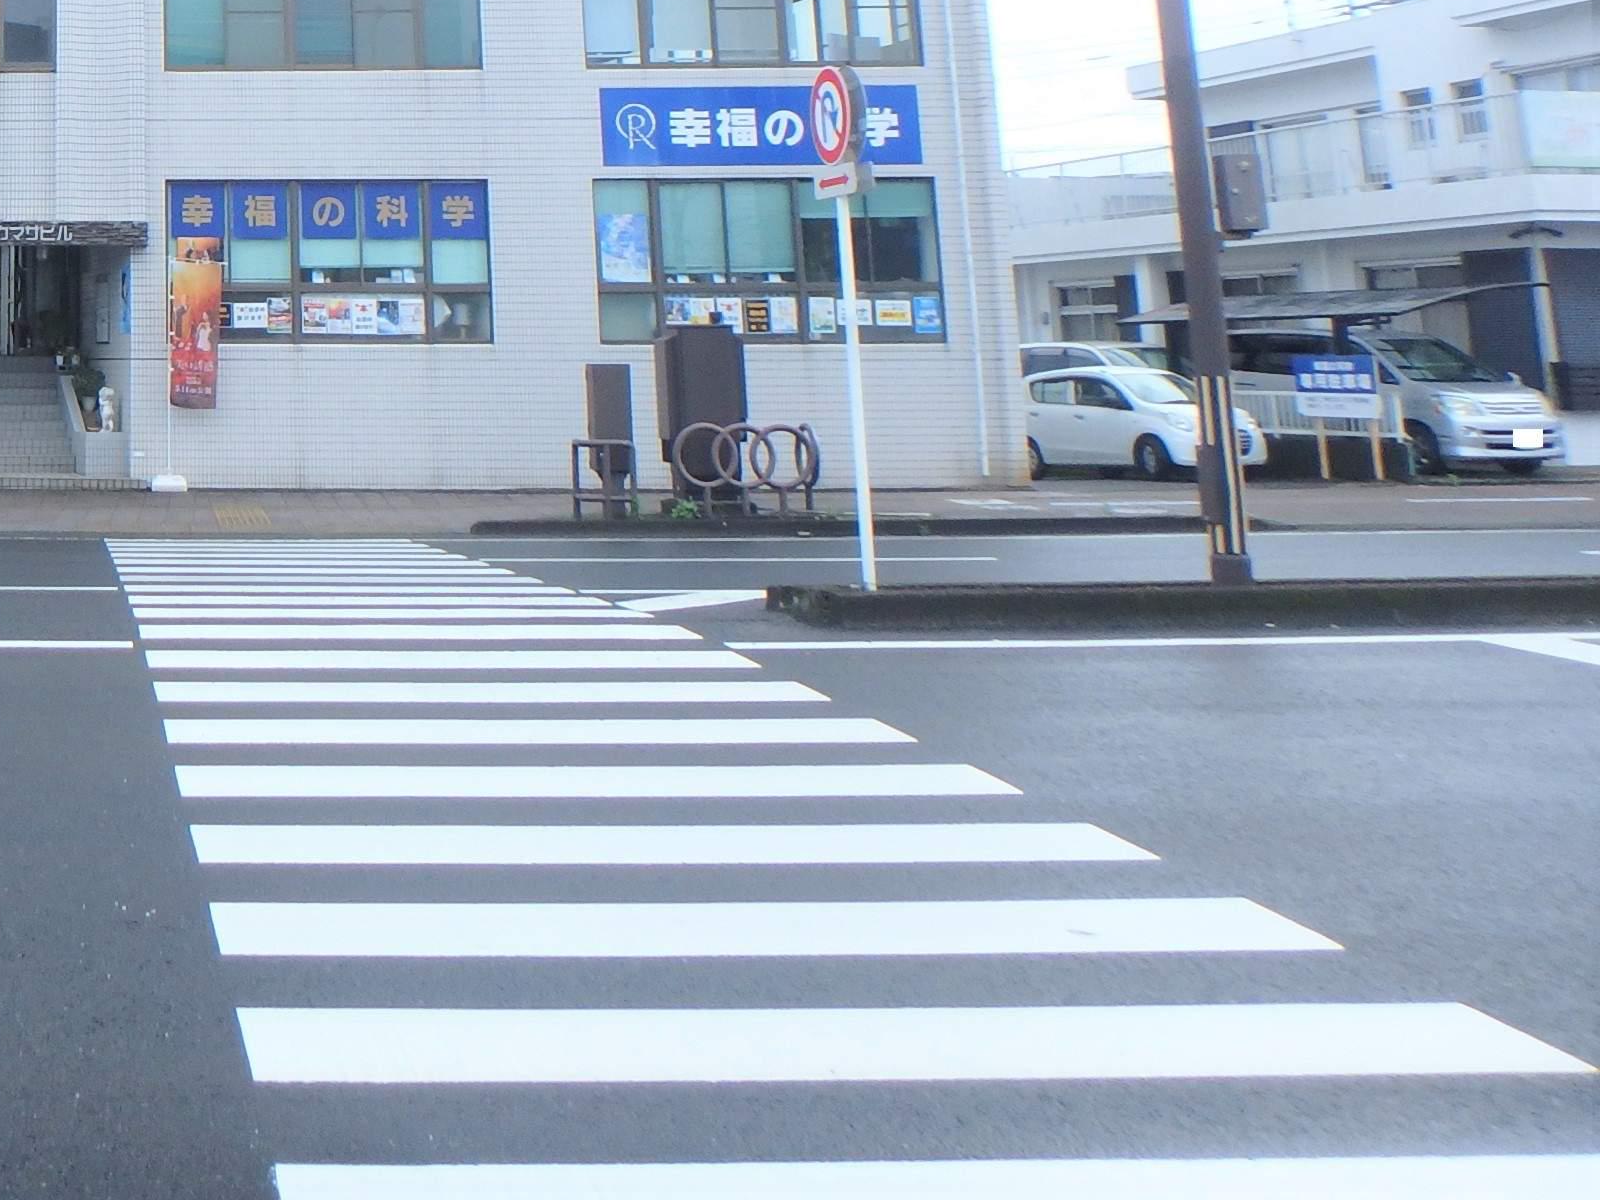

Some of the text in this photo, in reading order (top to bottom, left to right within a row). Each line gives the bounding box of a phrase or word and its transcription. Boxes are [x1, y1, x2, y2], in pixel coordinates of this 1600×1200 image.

[668, 107, 901, 148] 幸福の学
[181, 194, 475, 228] 幸福の科学
